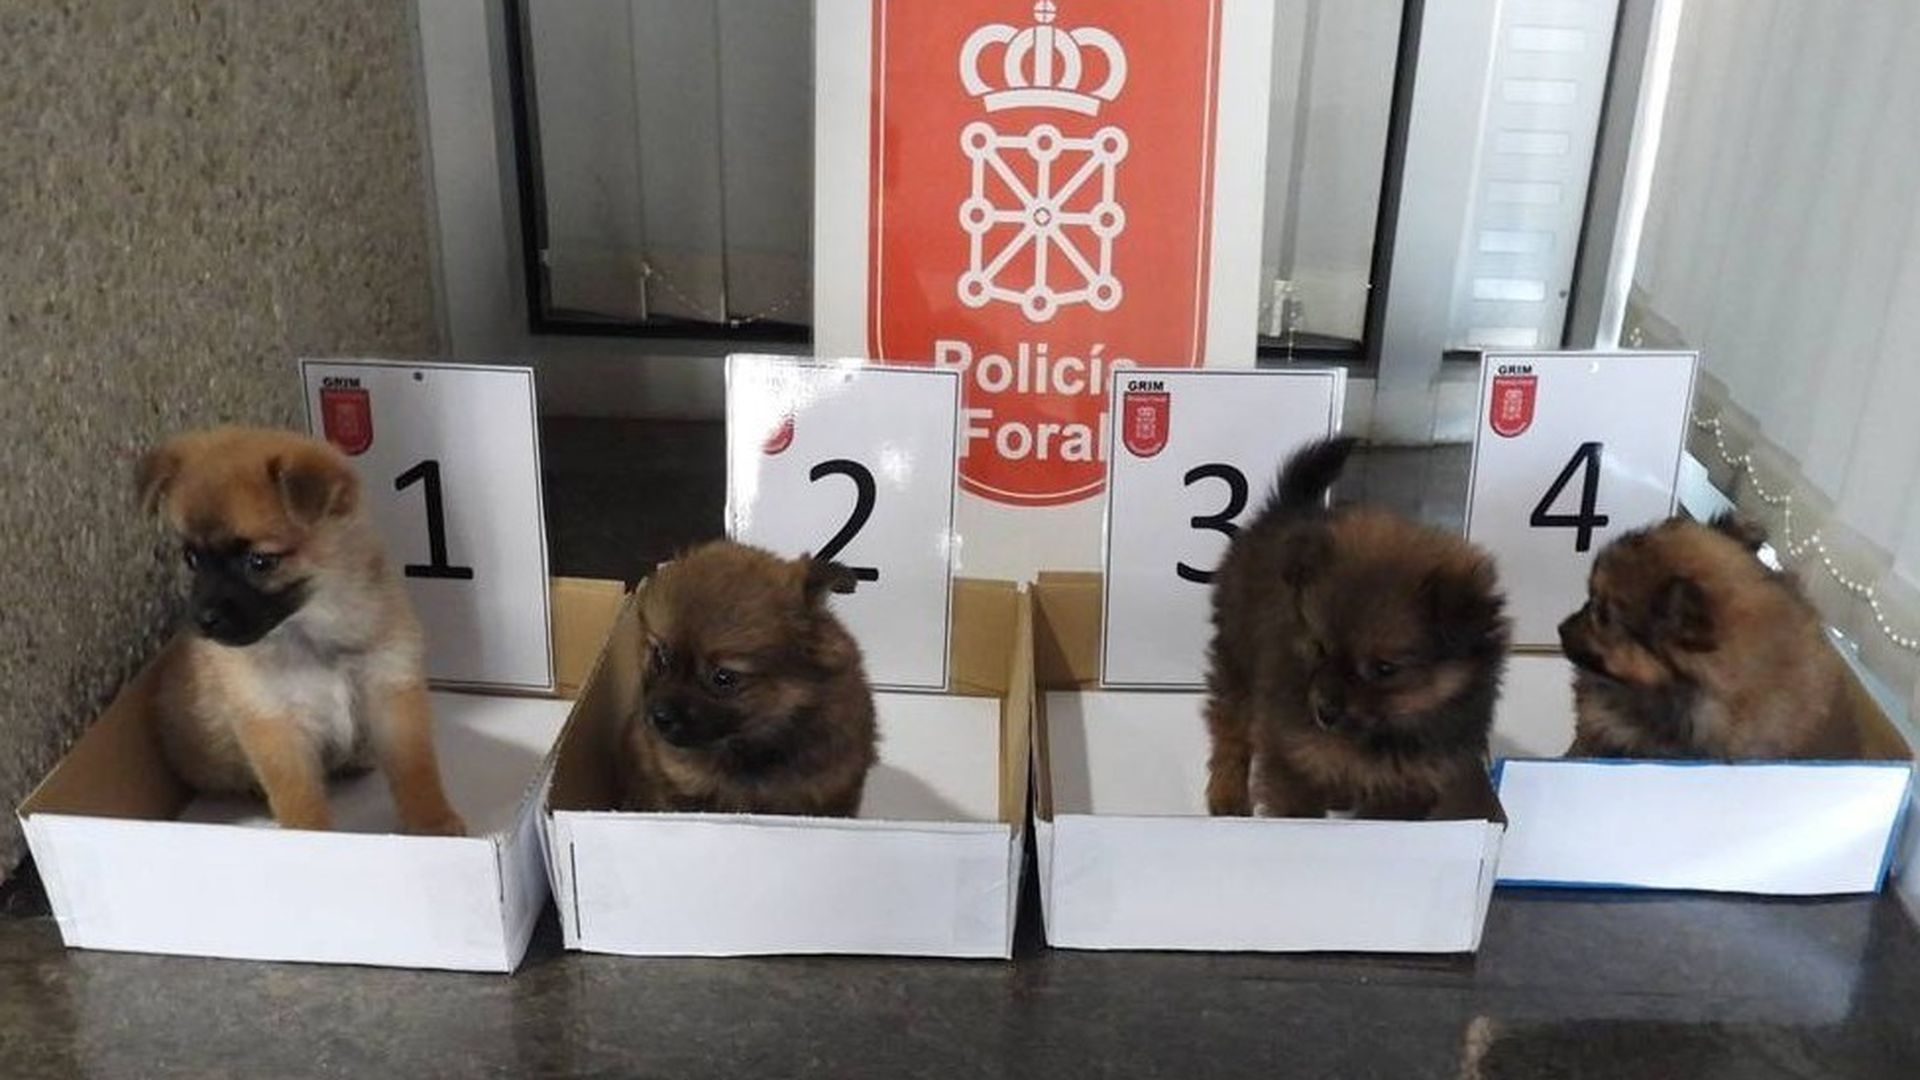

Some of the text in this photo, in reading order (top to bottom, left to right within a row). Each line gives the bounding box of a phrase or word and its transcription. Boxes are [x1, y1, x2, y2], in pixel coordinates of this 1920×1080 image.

[323, 376, 361, 388] GRIM
[934, 340, 1138, 396] Policí
[1127, 380, 1165, 392] GRIM
[1498, 364, 1533, 375] GRIM
[959, 408, 1109, 462] Foral
[394, 460, 474, 581] 1
[810, 459, 879, 582] 2
[1177, 463, 1249, 585] 3
[1530, 442, 1609, 552] 4
